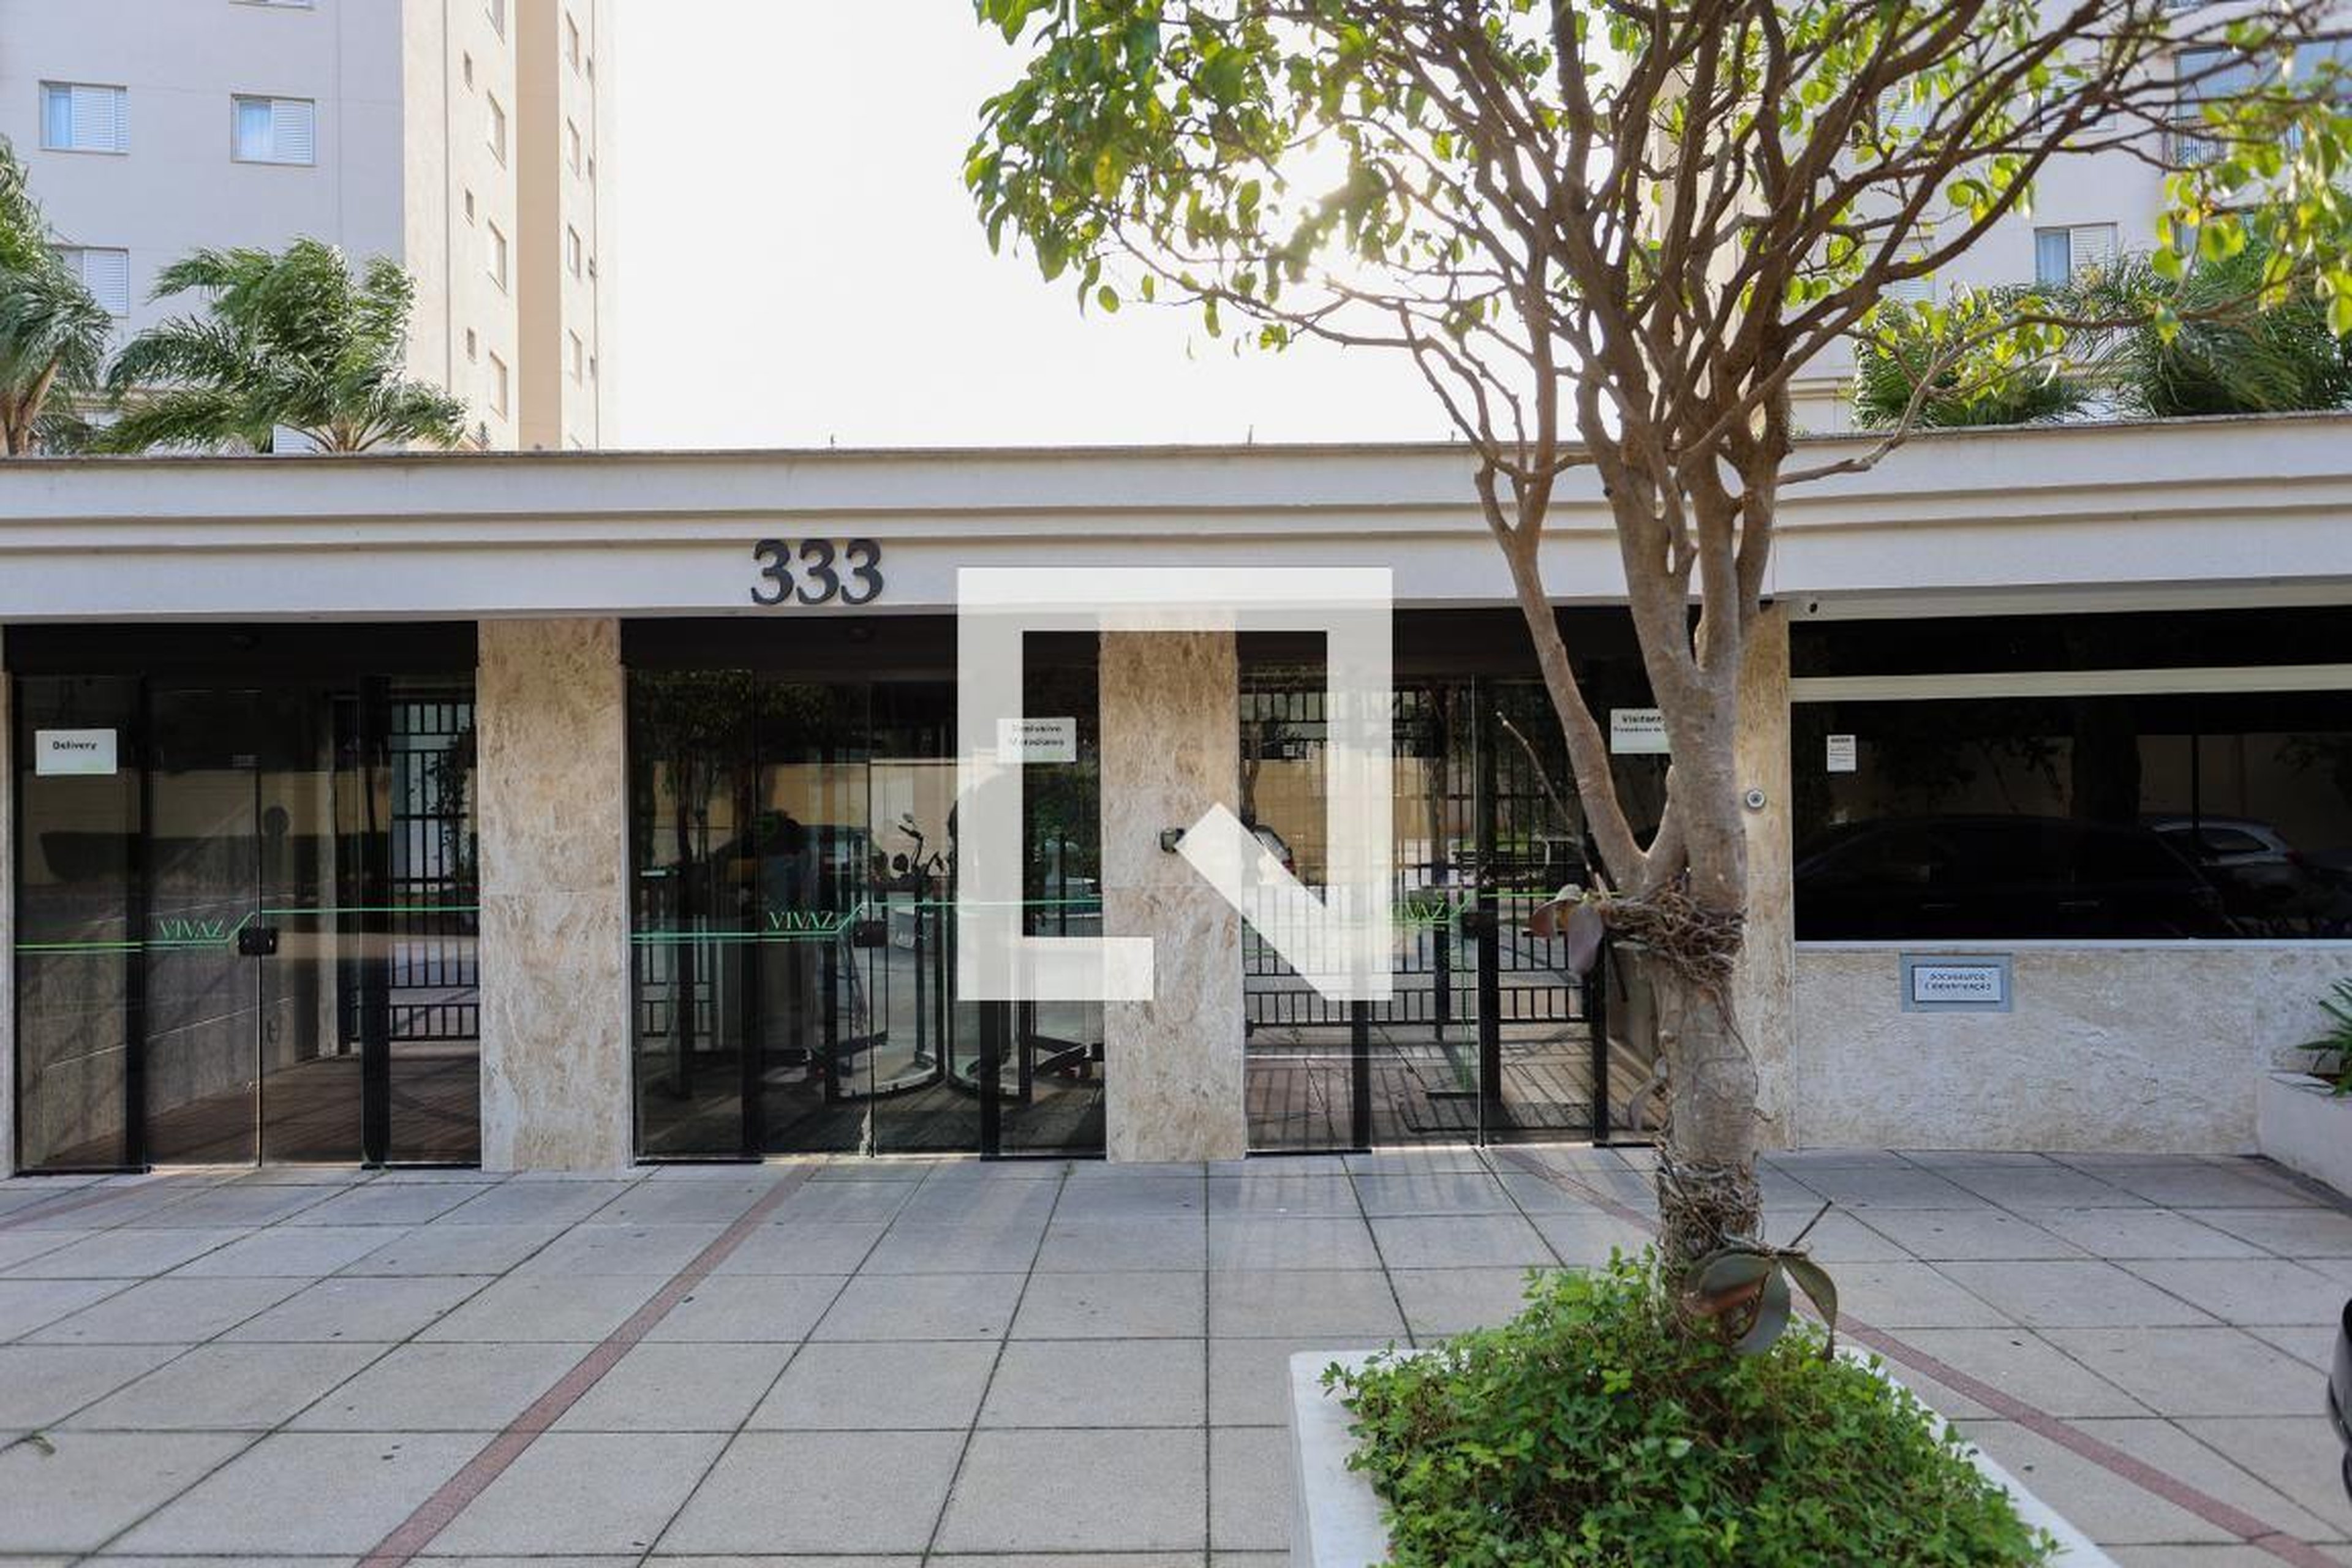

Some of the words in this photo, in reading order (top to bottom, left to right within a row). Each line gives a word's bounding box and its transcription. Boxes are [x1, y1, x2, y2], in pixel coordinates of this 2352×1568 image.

[751, 539, 884, 605] 333
[53, 741, 97, 750] Delivery
[160, 918, 225, 938] VIVAZ
[769, 910, 834, 929] VIVAZ
